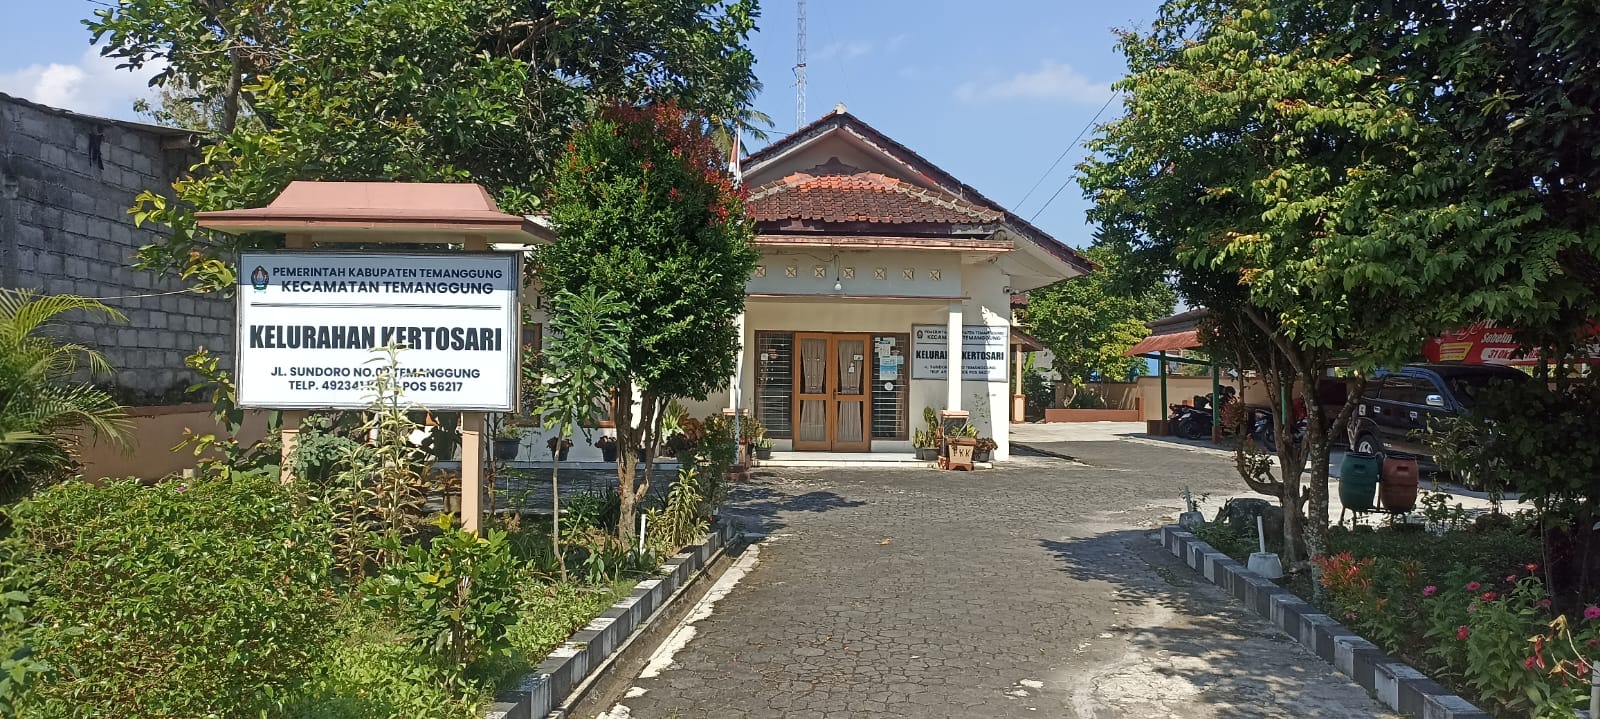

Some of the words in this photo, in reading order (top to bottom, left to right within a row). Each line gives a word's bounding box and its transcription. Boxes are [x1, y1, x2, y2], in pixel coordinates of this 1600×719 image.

[273, 267, 345, 278] PEMERINTAH
[348, 267, 417, 278] KABUPATEN
[419, 268, 503, 279] TEMANGGUNG
[281, 280, 380, 293] KECAMATAN
[383, 281, 494, 294] TEMANGGUNG
[250, 325, 375, 350] KELURAHAN
[381, 326, 502, 351] KERTOSARI
[962, 352, 1004, 360] KERTOSARI
[271, 366, 287, 377] JL.
[290, 366, 350, 378] SUNDORO
[393, 367, 481, 379] TEMANGGUNG
[288, 380, 319, 391] TELP.
[403, 381, 427, 392] POS
[430, 382, 463, 392] 56217
